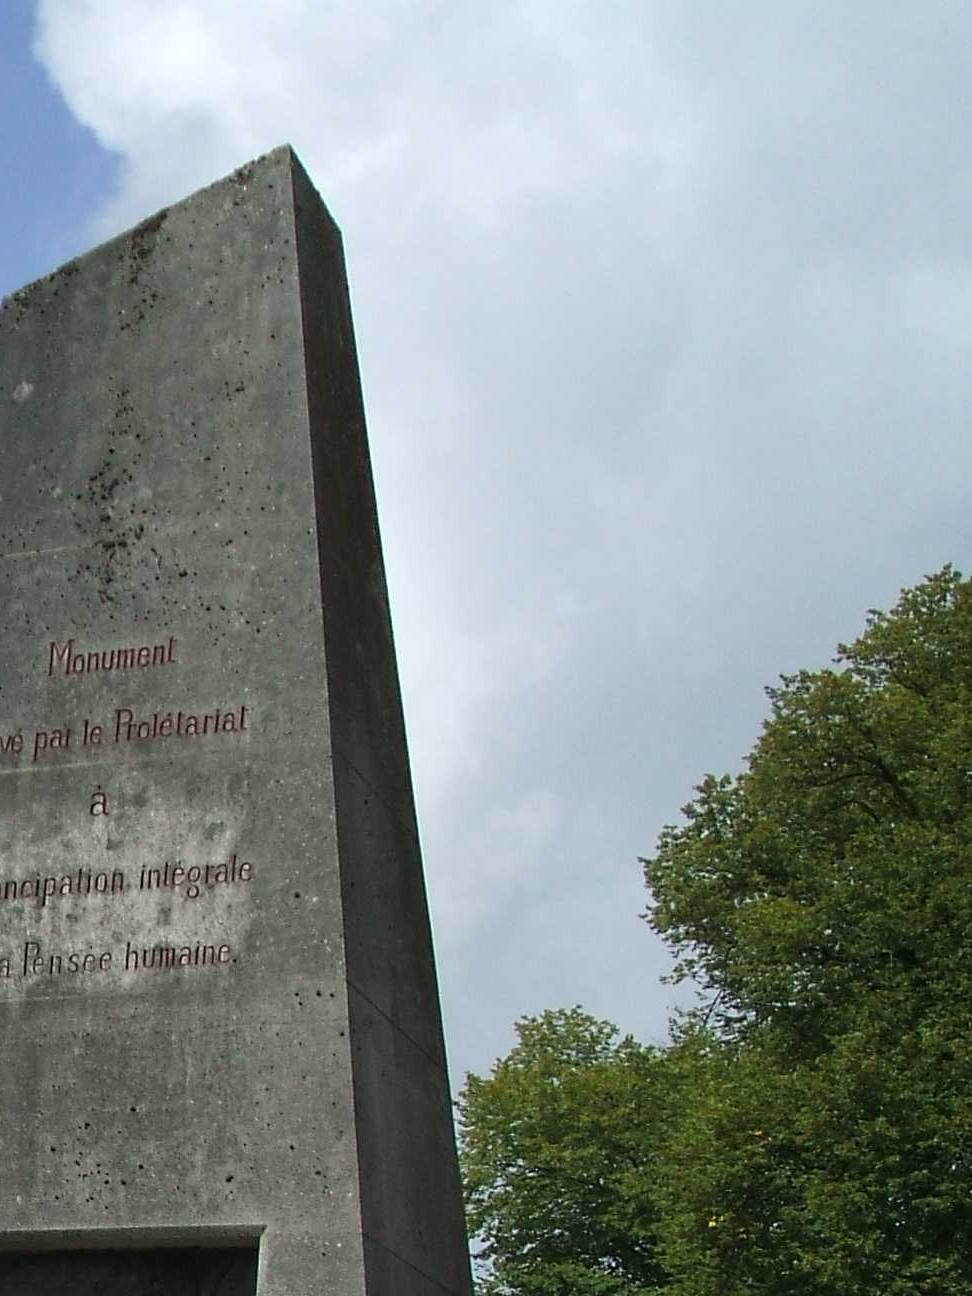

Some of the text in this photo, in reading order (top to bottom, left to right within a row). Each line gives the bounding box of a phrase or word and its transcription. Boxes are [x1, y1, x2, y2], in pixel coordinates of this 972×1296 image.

[48, 636, 177, 677] Monument
[32, 728, 71, 761] par
[82, 718, 103, 745] le
[114, 705, 249, 744] Prolétariat
[90, 784, 109, 817] à
[139, 854, 253, 899] intégrale
[23, 940, 113, 977] Pensée
